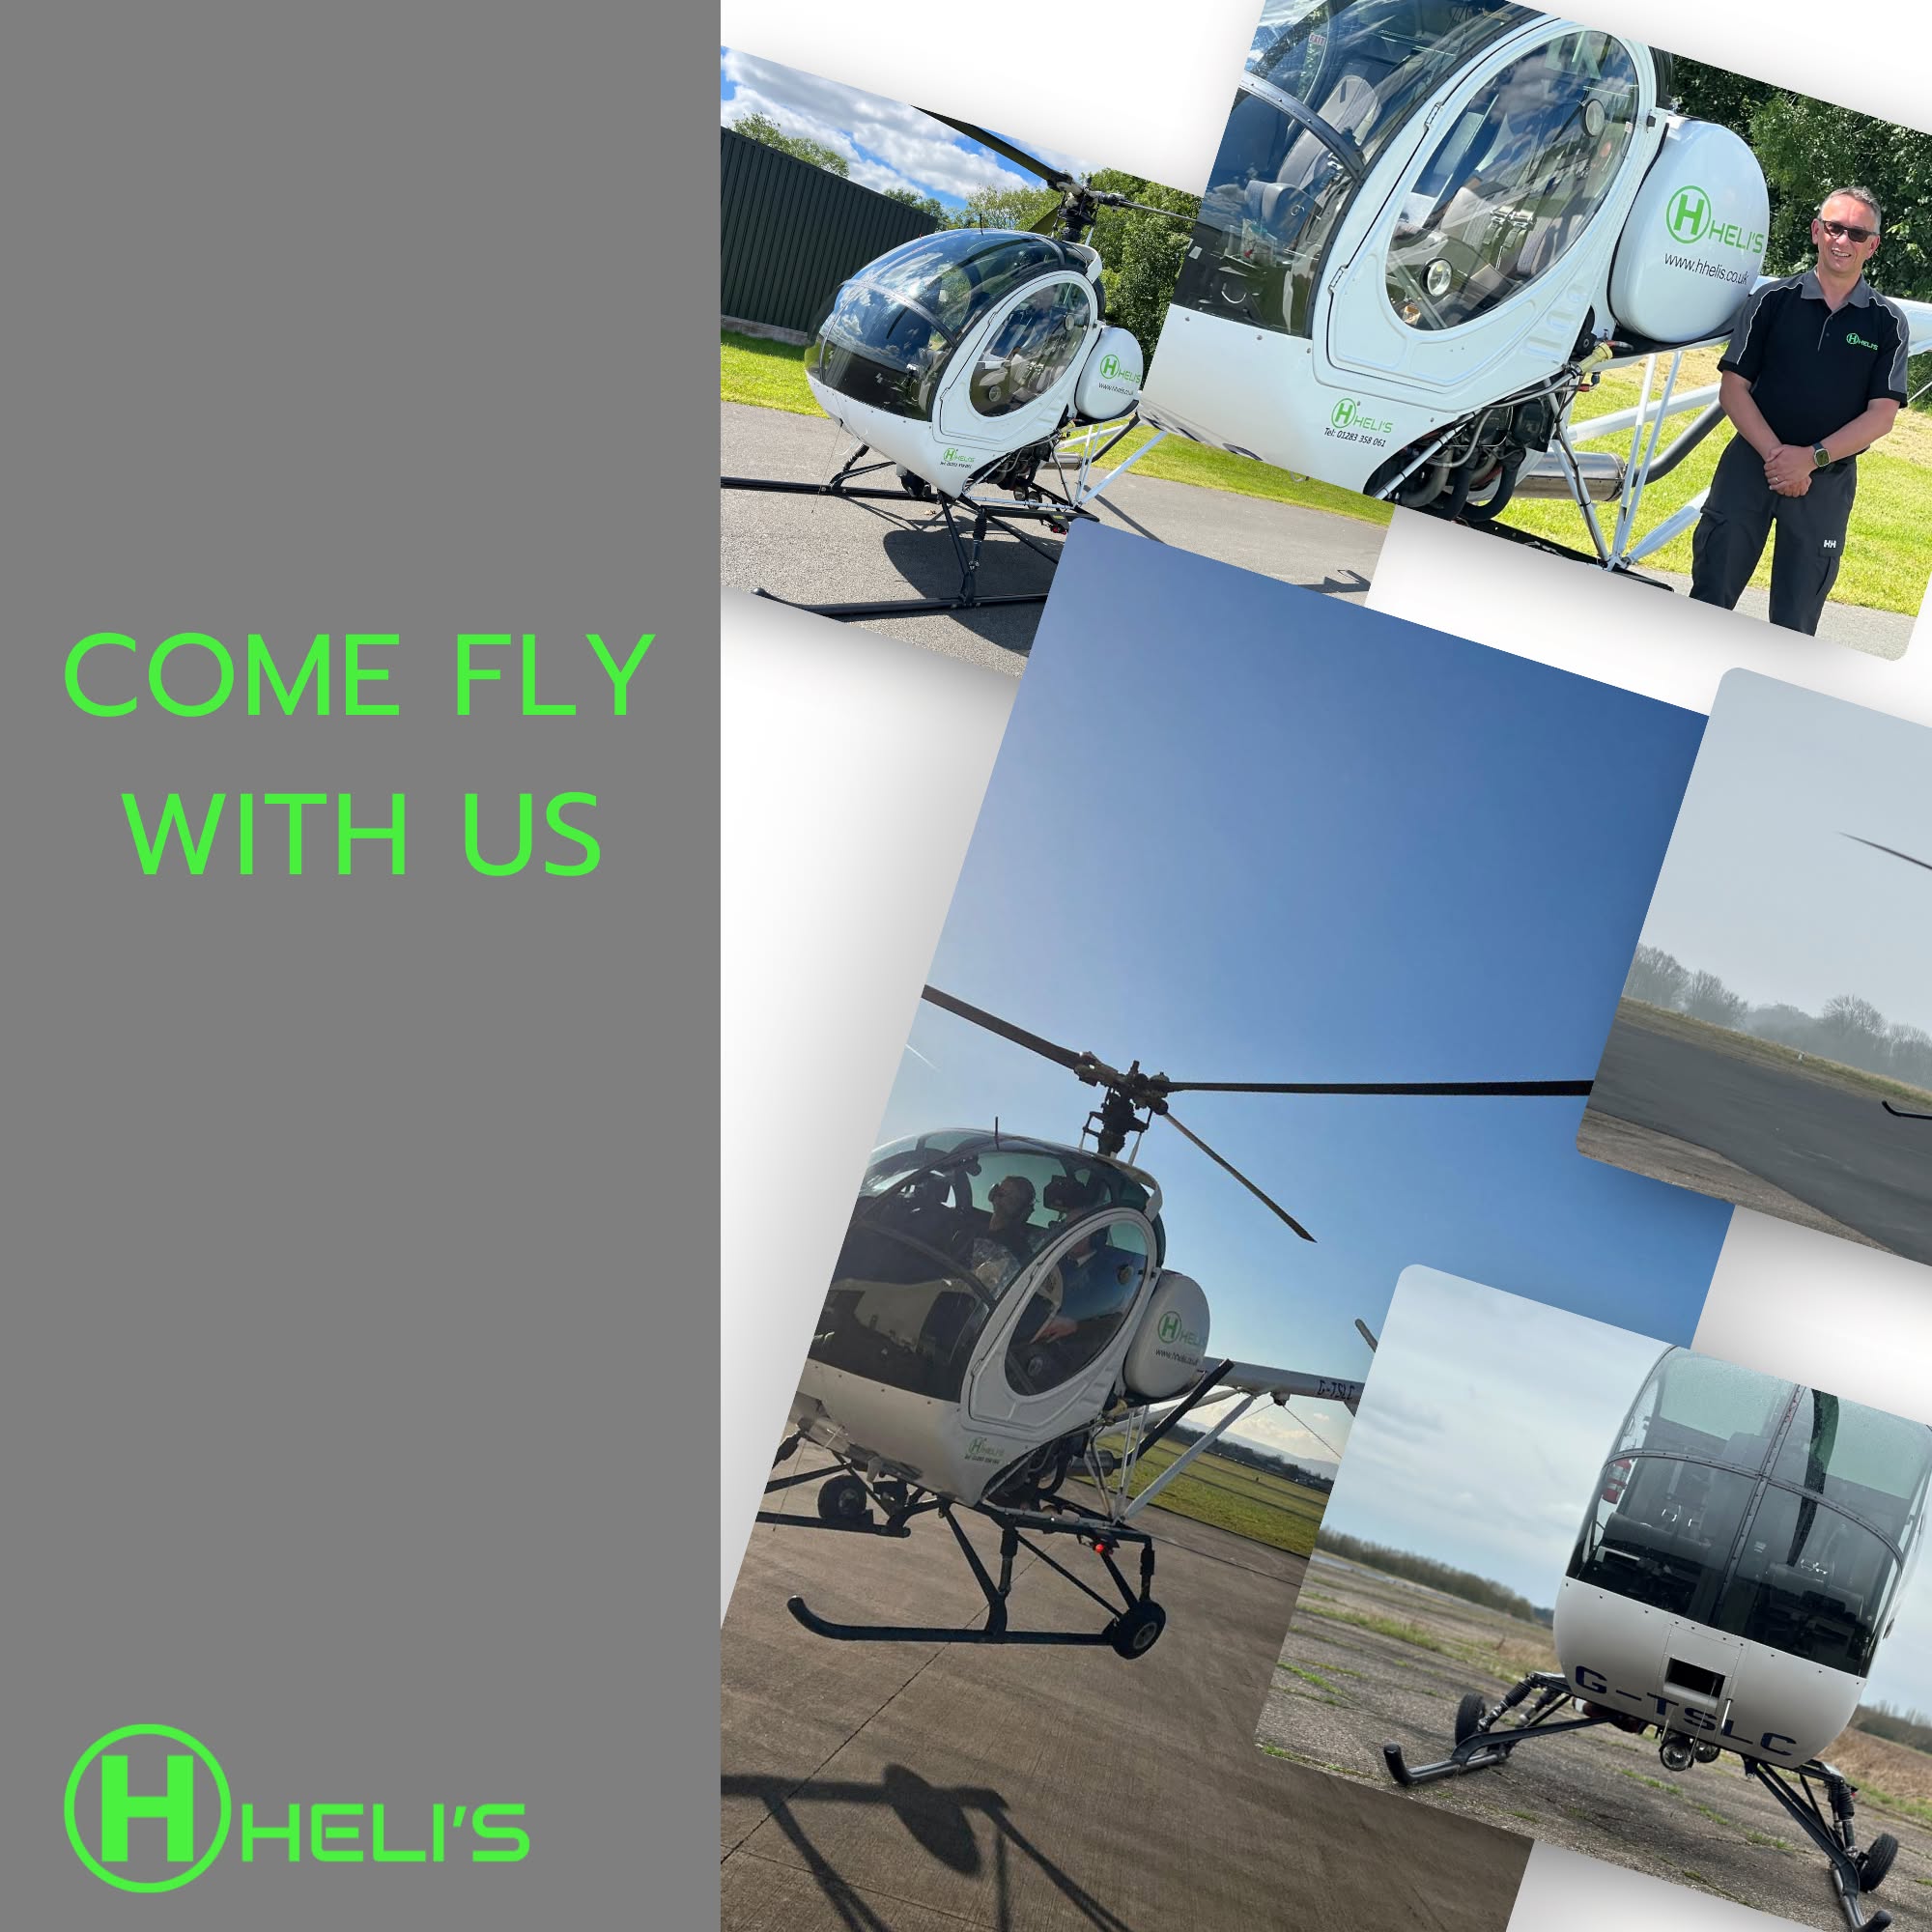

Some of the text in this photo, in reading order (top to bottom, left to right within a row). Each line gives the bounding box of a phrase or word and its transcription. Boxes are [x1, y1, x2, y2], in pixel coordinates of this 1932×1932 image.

[1309, 35, 1325, 45] EXIT
[1708, 219, 1764, 254] HELI'S
[1663, 252, 1749, 285] www.hhelis.co.uk
[1353, 415, 1393, 434] HELI'S
[1324, 427, 1386, 447] Tel: 01283 358 061
[1823, 539, 1837, 549] HH
[1575, 1664, 1798, 1757] G-TSLC
